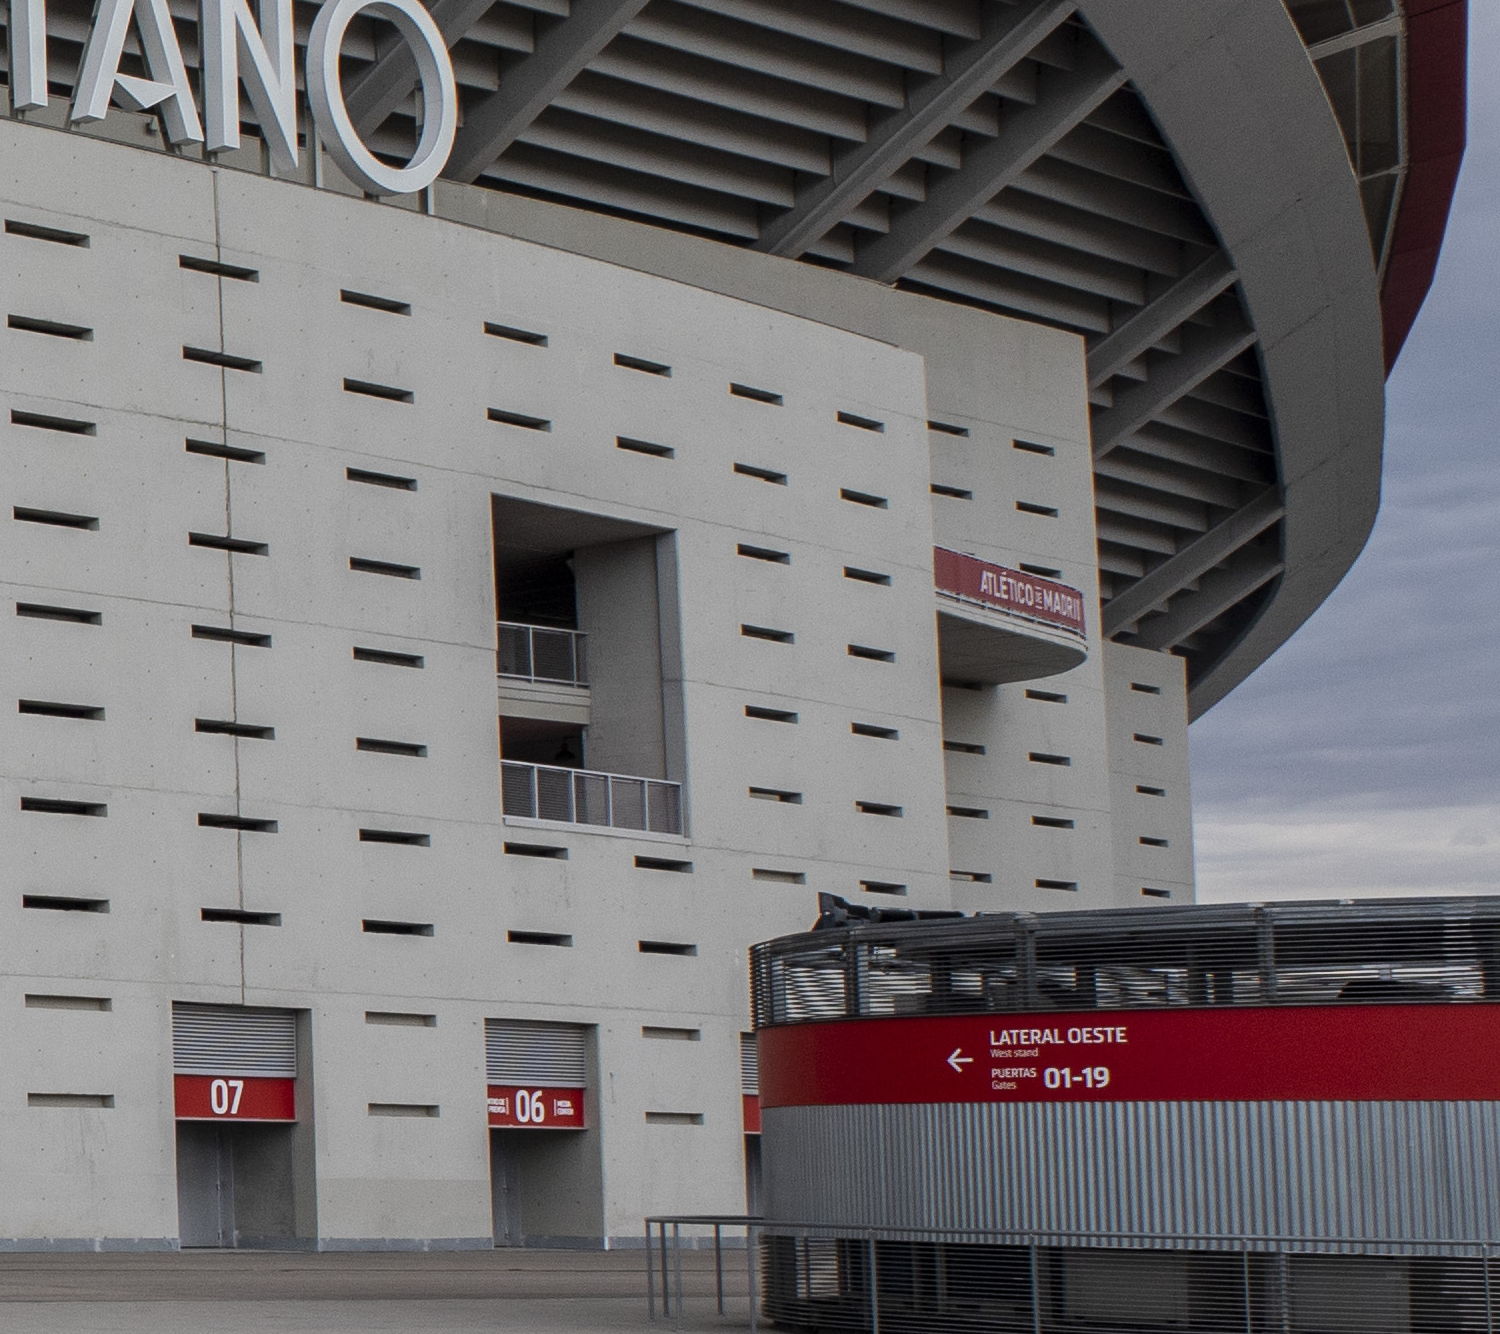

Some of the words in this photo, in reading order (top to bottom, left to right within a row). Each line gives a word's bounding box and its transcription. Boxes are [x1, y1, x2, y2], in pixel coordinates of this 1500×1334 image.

[980, 570, 1034, 606] ATLÉTICO
[989, 1028, 1065, 1046] LATERAL
[1067, 1026, 1129, 1044] OESTE
[990, 1048, 1012, 1058] West
[1013, 1048, 1039, 1058] stand
[991, 1067, 1038, 1079] PUERTAS
[1043, 1066, 1111, 1090] 01-19
[209, 1078, 245, 1115] 07
[515, 1089, 546, 1124] 06
